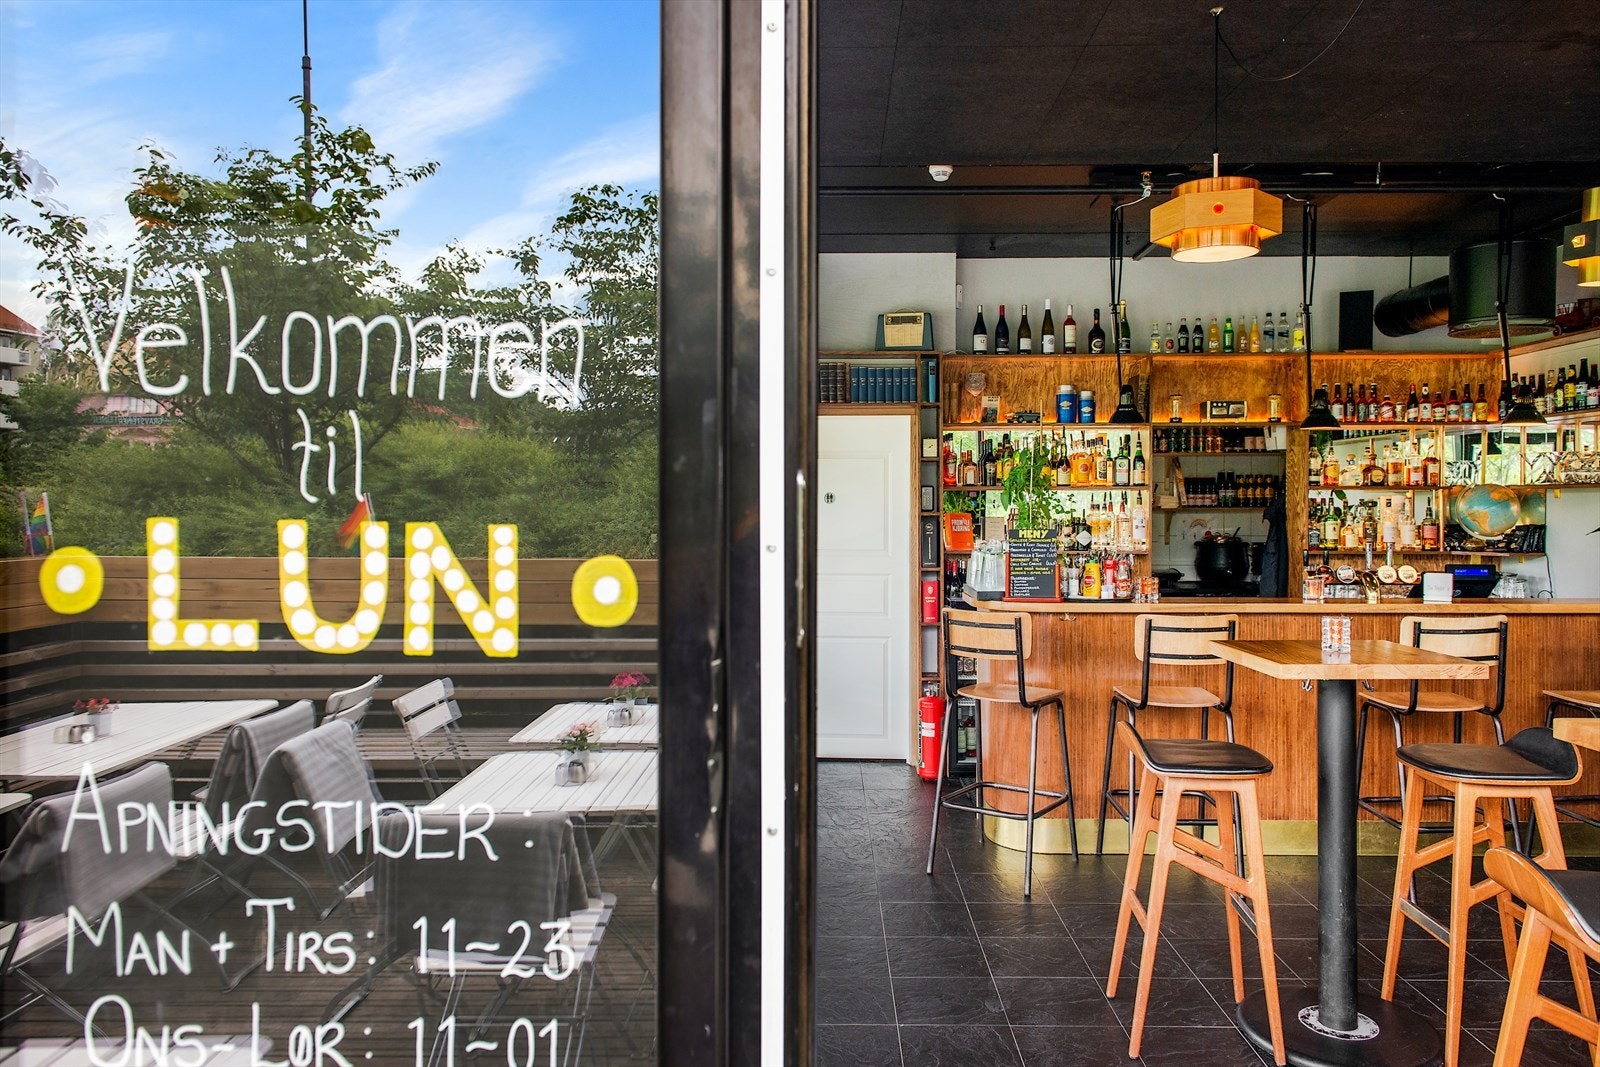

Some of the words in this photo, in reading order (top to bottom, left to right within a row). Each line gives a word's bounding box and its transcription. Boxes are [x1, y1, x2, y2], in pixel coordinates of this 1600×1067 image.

[64, 257, 586, 402] Velkommen
[292, 407, 366, 503] til
[1018, 529, 1049, 539] MENY
[146, 517, 519, 658] LUN
[65, 901, 192, 977] MAN
